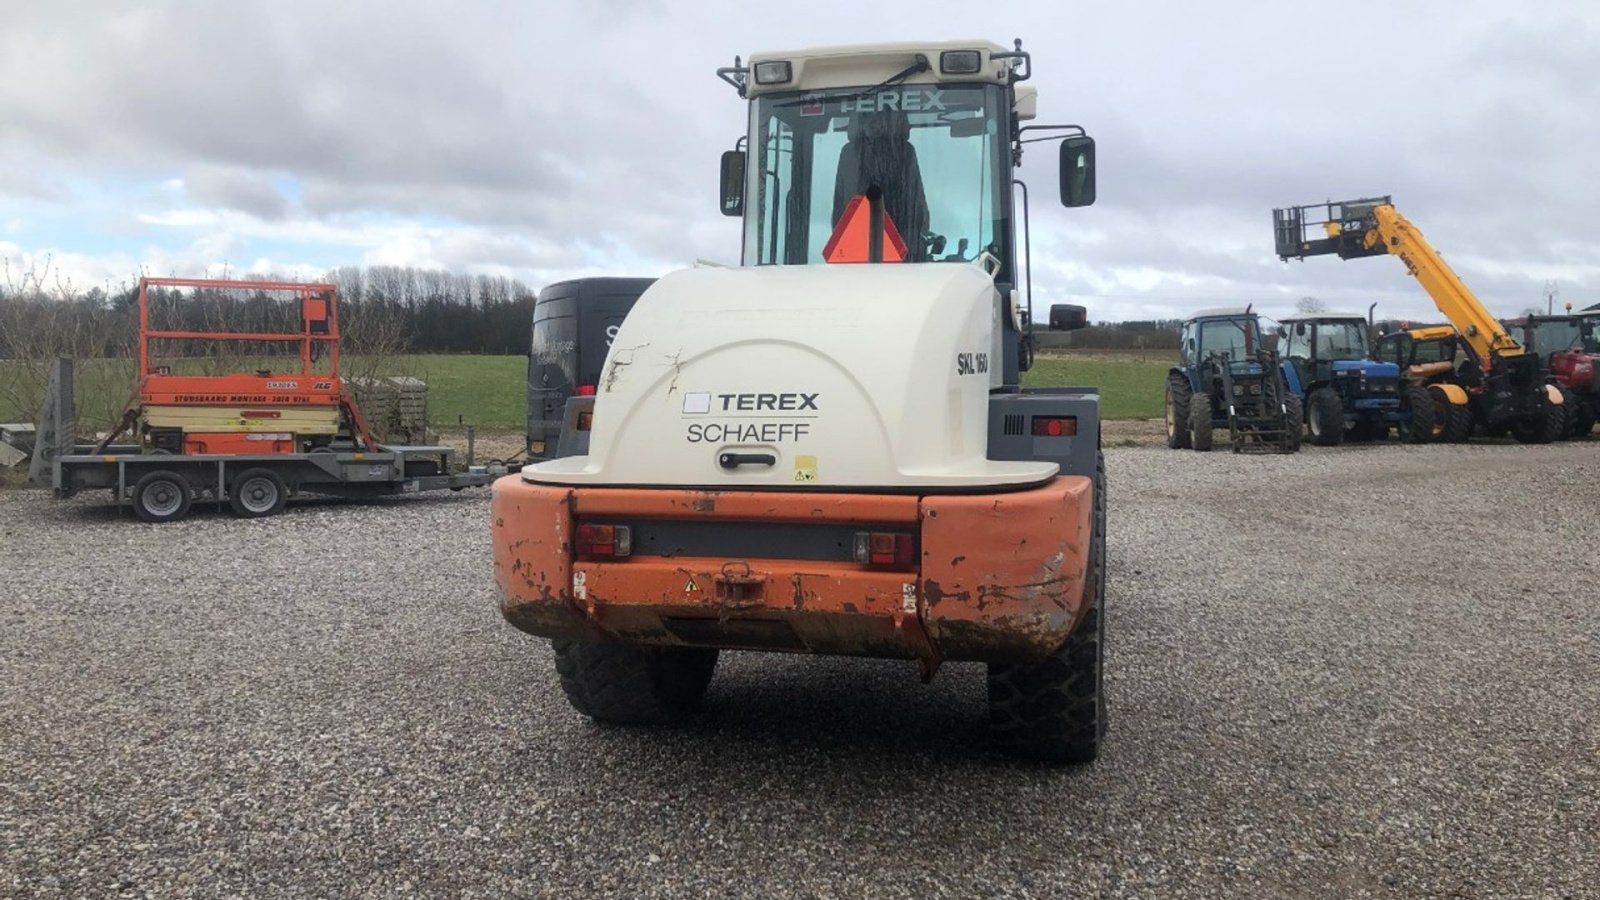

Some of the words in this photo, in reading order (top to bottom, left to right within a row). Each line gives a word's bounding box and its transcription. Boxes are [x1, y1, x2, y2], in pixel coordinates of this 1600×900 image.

[834, 90, 946, 112] TEREX
[957, 352, 975, 376] SKL
[975, 352, 988, 374] 160
[313, 382, 332, 390] JLG
[718, 393, 820, 411] TEREX
[687, 423, 810, 442] SCHAEFF
